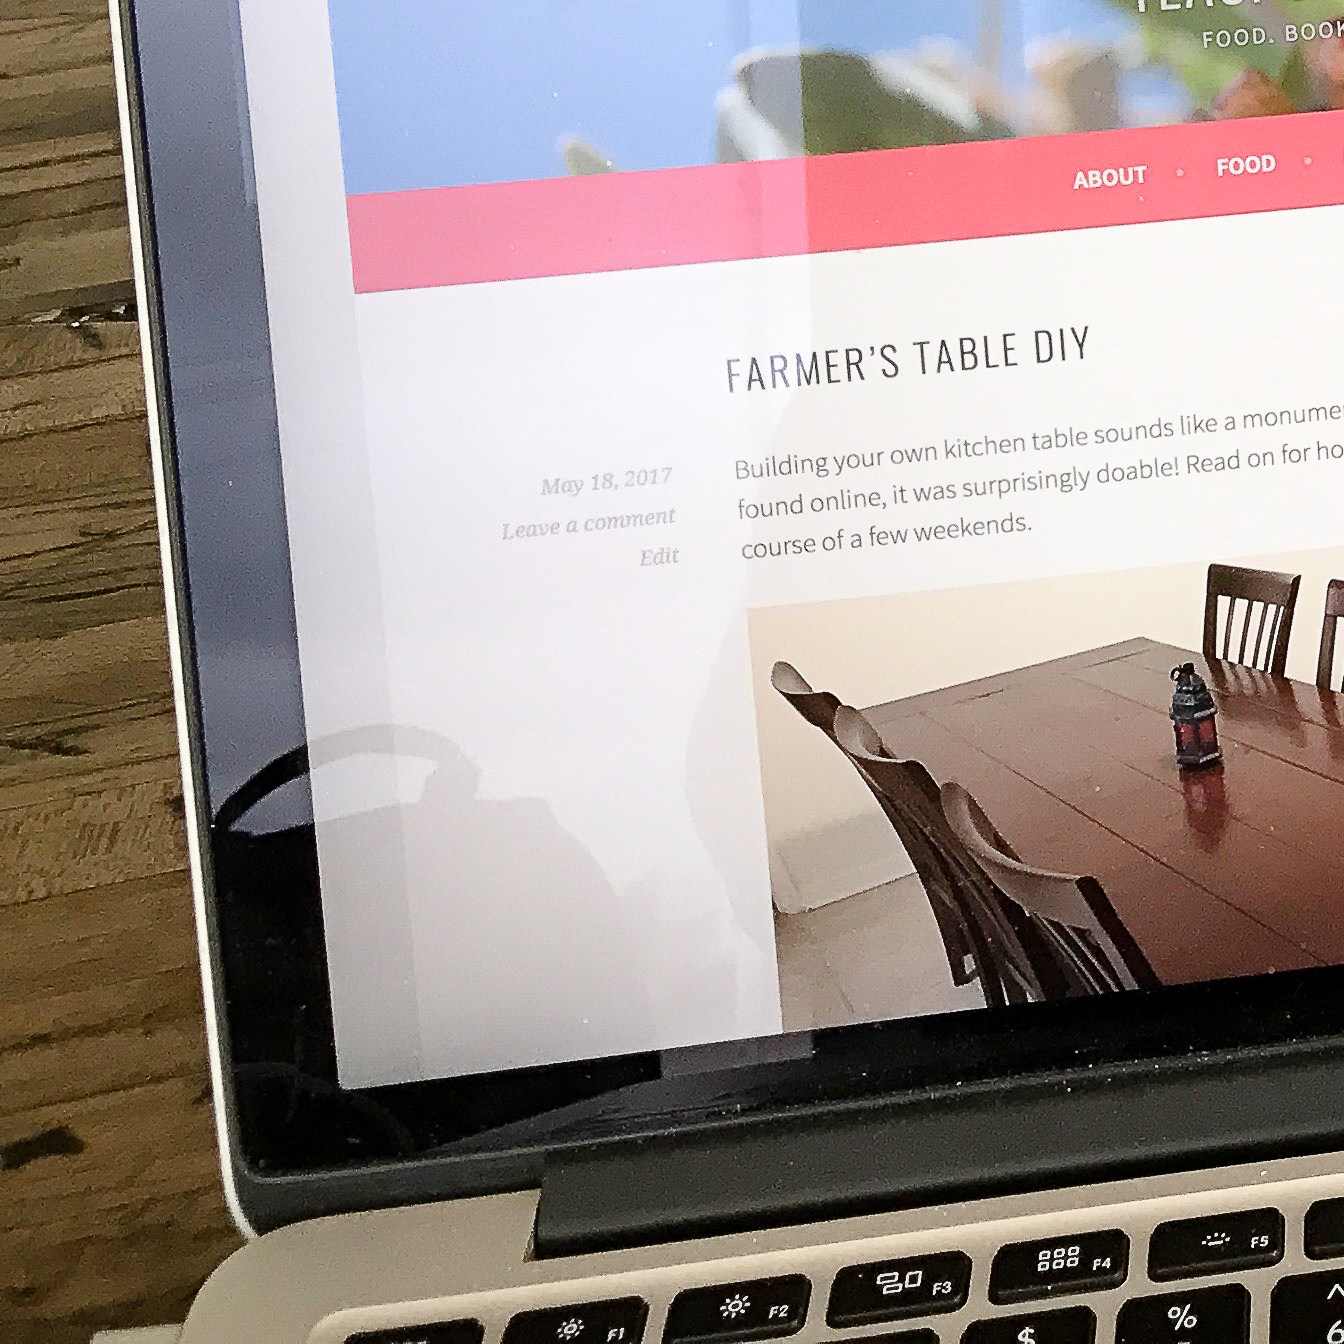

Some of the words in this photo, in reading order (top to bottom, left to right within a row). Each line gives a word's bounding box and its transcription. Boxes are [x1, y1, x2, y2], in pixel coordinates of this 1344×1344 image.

[1202, 26, 1275, 49] FOOD.
[1073, 164, 1147, 190] ABOUT
[1217, 152, 1276, 176] FOOD
[913, 333, 1019, 376] TABLE
[1034, 326, 1090, 364] DIY
[735, 452, 829, 482] Building
[833, 447, 885, 474] your
[890, 442, 938, 464] own
[945, 431, 1025, 461] kitchen
[1031, 424, 1089, 453] table
[1093, 416, 1174, 445] sounds
[1180, 412, 1217, 436] like
[1224, 412, 1236, 431] a
[540, 475, 584, 499] May
[591, 472, 619, 495] 18,
[625, 467, 673, 488] 2017
[738, 493, 805, 520] found
[810, 485, 887, 515] online,
[892, 484, 907, 507] it
[912, 480, 957, 503] was
[963, 465, 1090, 499] surprisingly
[1096, 456, 1180, 484] doable!
[1186, 450, 1241, 474] Read
[1248, 448, 1276, 467] on
[1281, 441, 1311, 464] for
[502, 519, 562, 540] Leave
[566, 517, 578, 534] a
[584, 506, 676, 531] comment
[741, 532, 815, 560] course
[821, 528, 845, 552] of
[850, 531, 862, 549] a
[869, 522, 908, 546] few
[914, 511, 1032, 543] weekends.
[640, 546, 679, 568] Edit
[1250, 1234, 1269, 1250] F5
[1092, 1257, 1111, 1273] F4
[932, 1280, 952, 1297] F3
[768, 1303, 788, 1320] F2
[607, 1327, 624, 1342] F1
